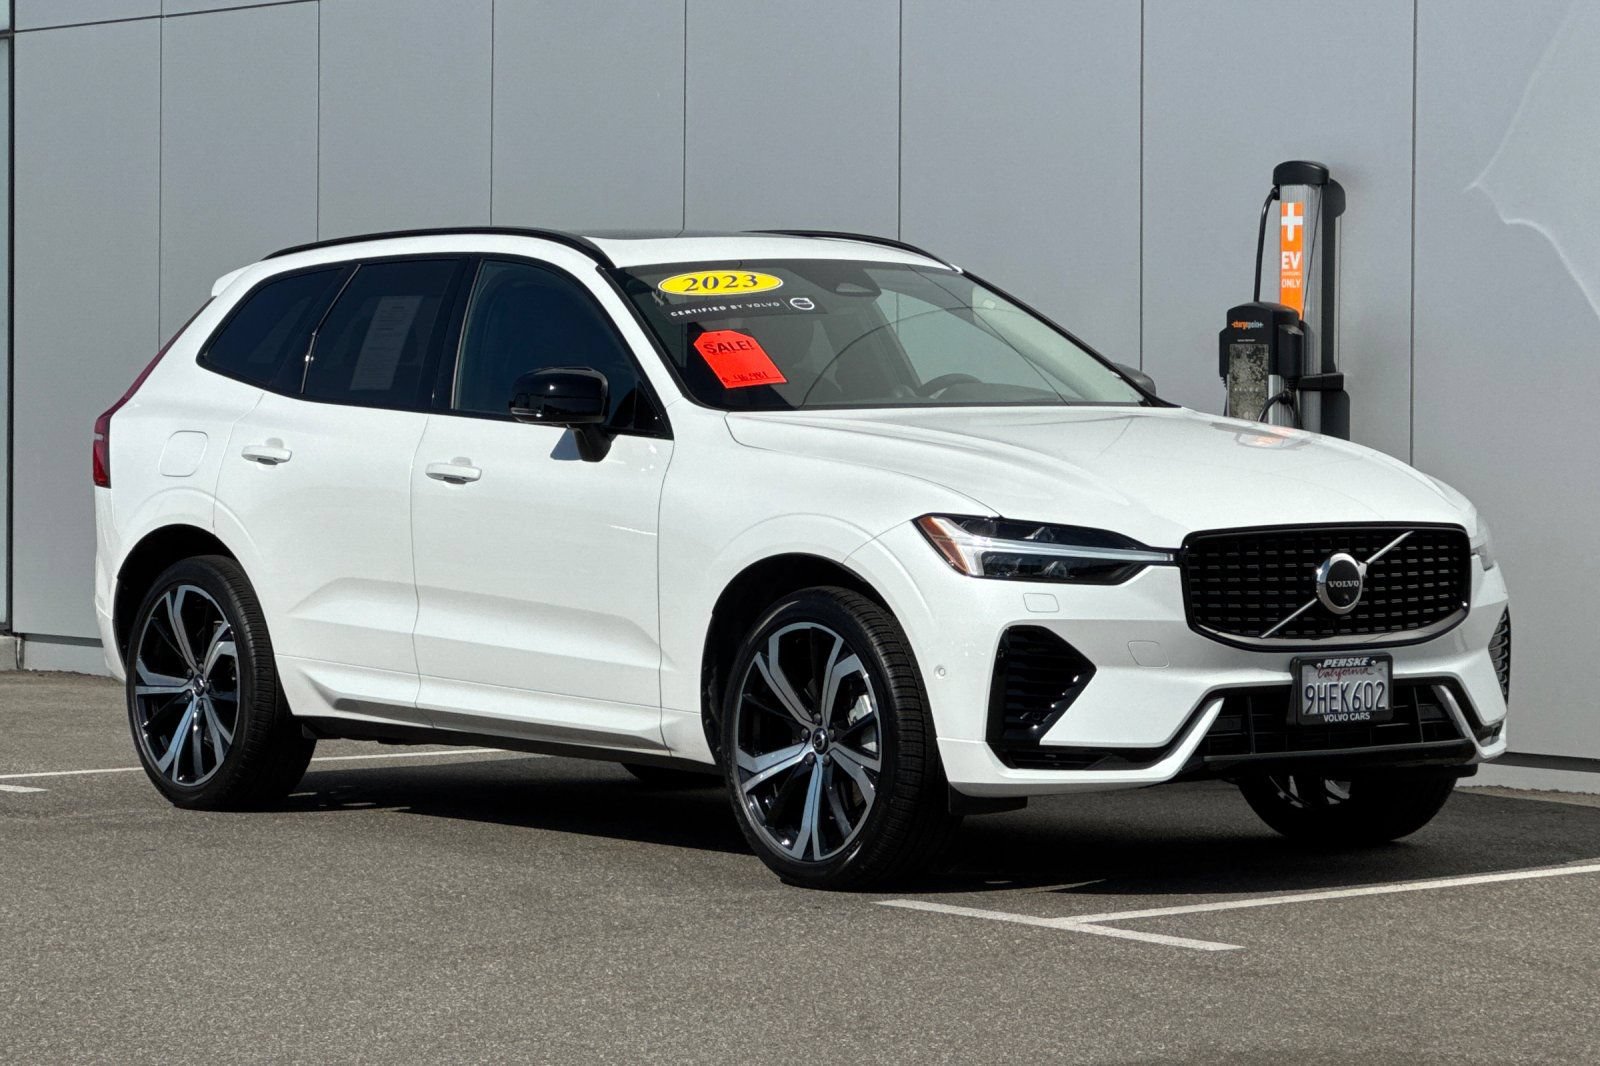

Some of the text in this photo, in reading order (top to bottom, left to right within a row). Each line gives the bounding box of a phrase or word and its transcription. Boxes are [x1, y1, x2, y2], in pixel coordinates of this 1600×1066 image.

[1281, 250, 1302, 270] EV
[682, 274, 759, 292] 2023
[1281, 278, 1302, 288] ONLY
[670, 304, 727, 317] CERTIFIED
[703, 340, 756, 355] SALE!
[1328, 580, 1360, 588] VOLVO
[1323, 657, 1370, 668] PENSKE
[1317, 667, 1375, 680] California
[1304, 680, 1386, 714] 9HEK602
[1323, 711, 1371, 722] VOLVO CARS
